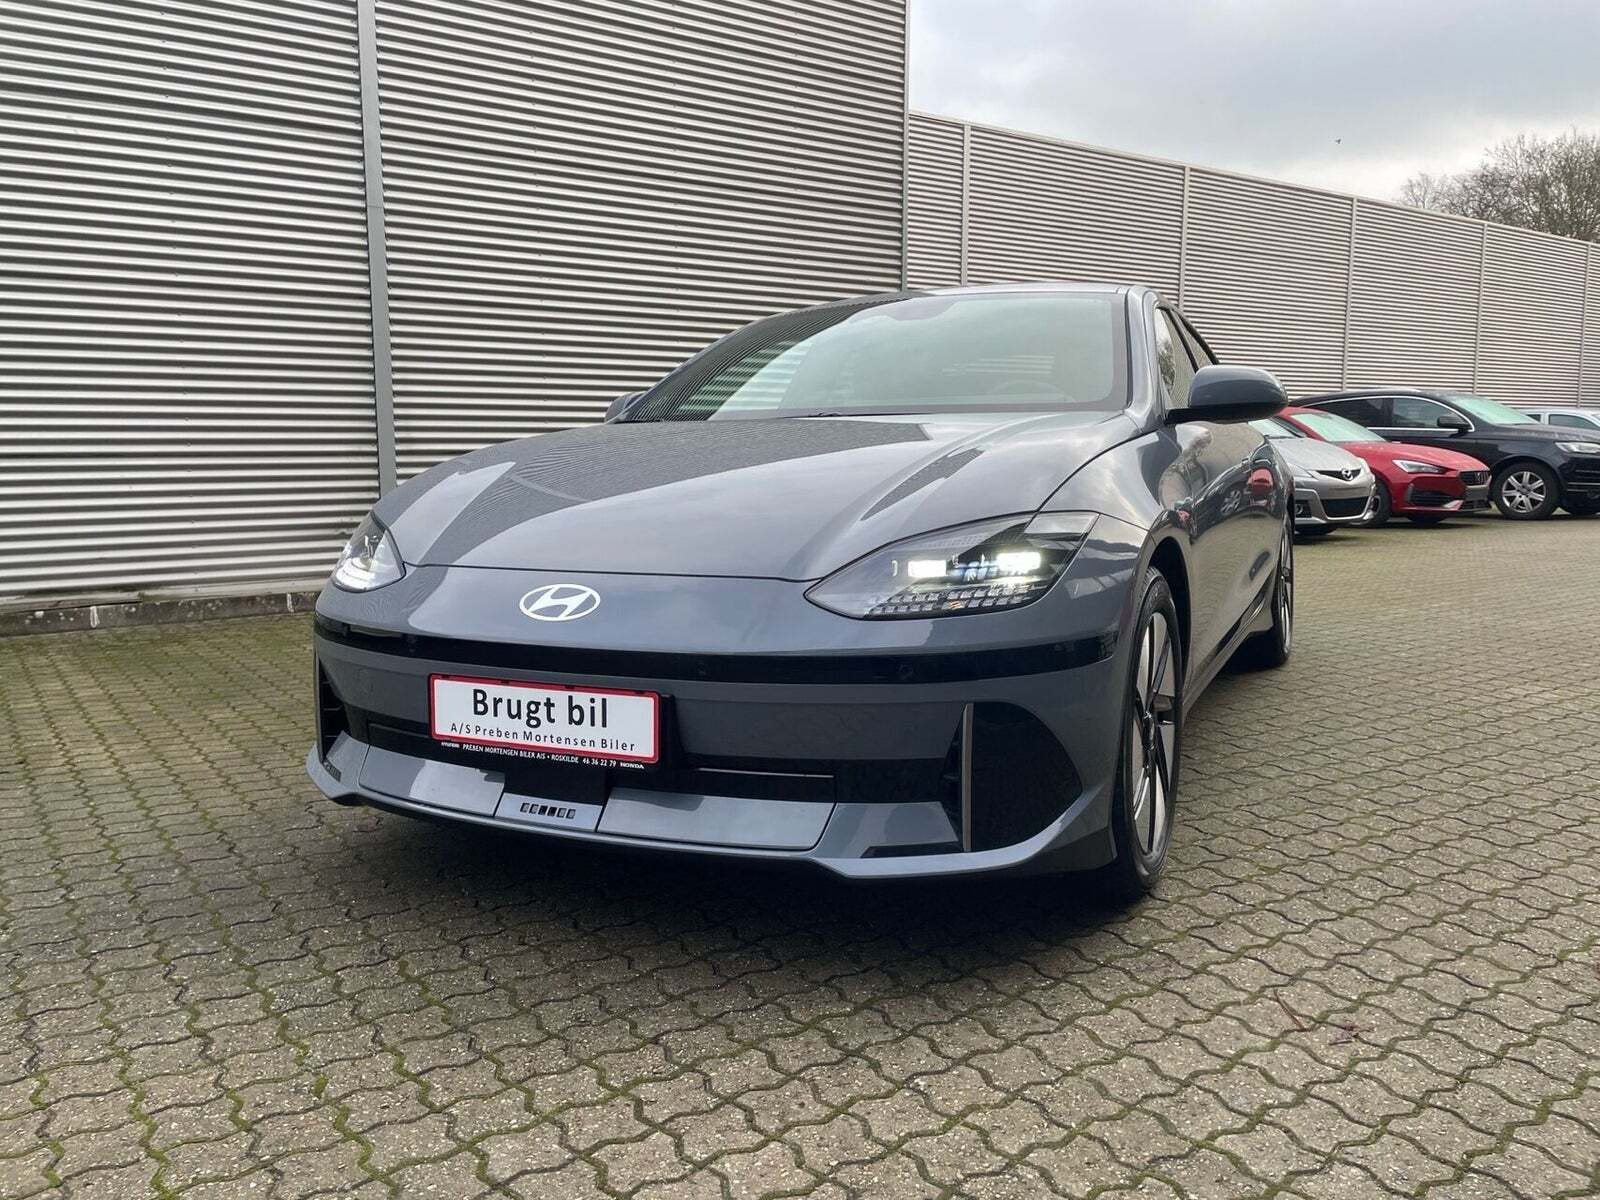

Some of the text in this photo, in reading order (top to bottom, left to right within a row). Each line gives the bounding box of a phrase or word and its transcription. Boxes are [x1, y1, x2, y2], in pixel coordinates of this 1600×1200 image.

[472, 688, 608, 728] Brugt bil
[450, 722, 635, 752] A/S Preben Mortensen Biler
[462, 743, 484, 752] PREBEN
[484, 747, 519, 757] MORTENSEN
[519, 751, 536, 759] BILER
[551, 753, 579, 764] ROSKILDE
[582, 757, 590, 765] 46
[600, 759, 608, 767] 22
